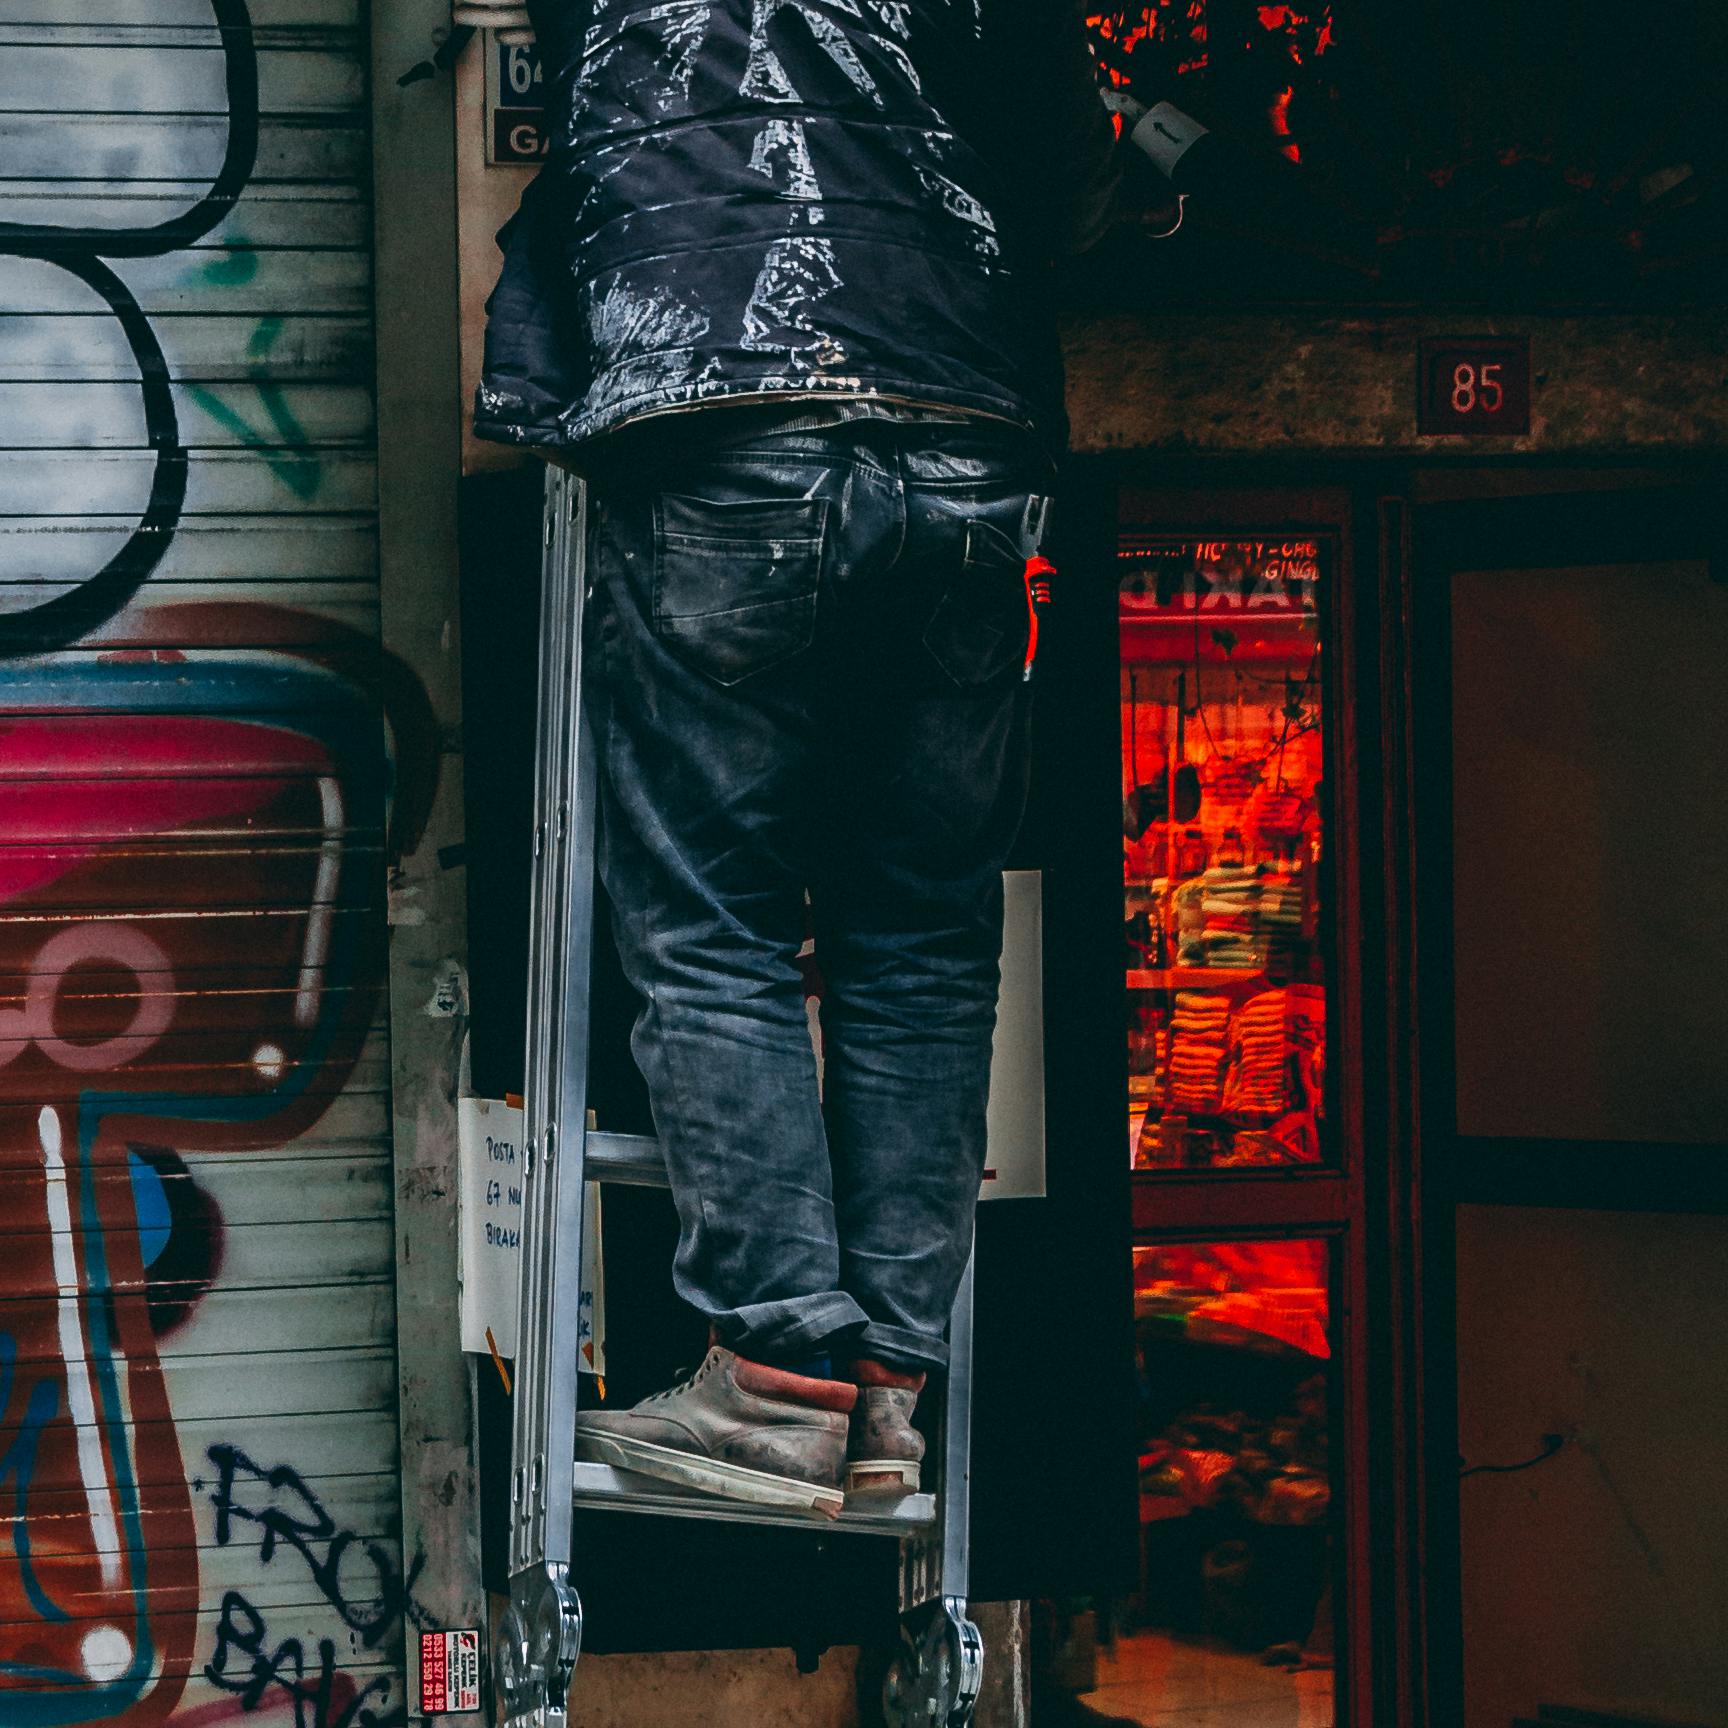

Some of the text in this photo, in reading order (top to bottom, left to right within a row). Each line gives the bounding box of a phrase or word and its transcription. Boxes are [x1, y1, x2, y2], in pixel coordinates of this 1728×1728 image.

[1450, 362, 1504, 414] 85
[485, 1135, 515, 1164] POSTA
[486, 1179, 500, 1208] 67
[423, 1633, 433, 1659] 0212
[433, 1633, 444, 1658] 0533
[434, 1660, 444, 1680] 527
